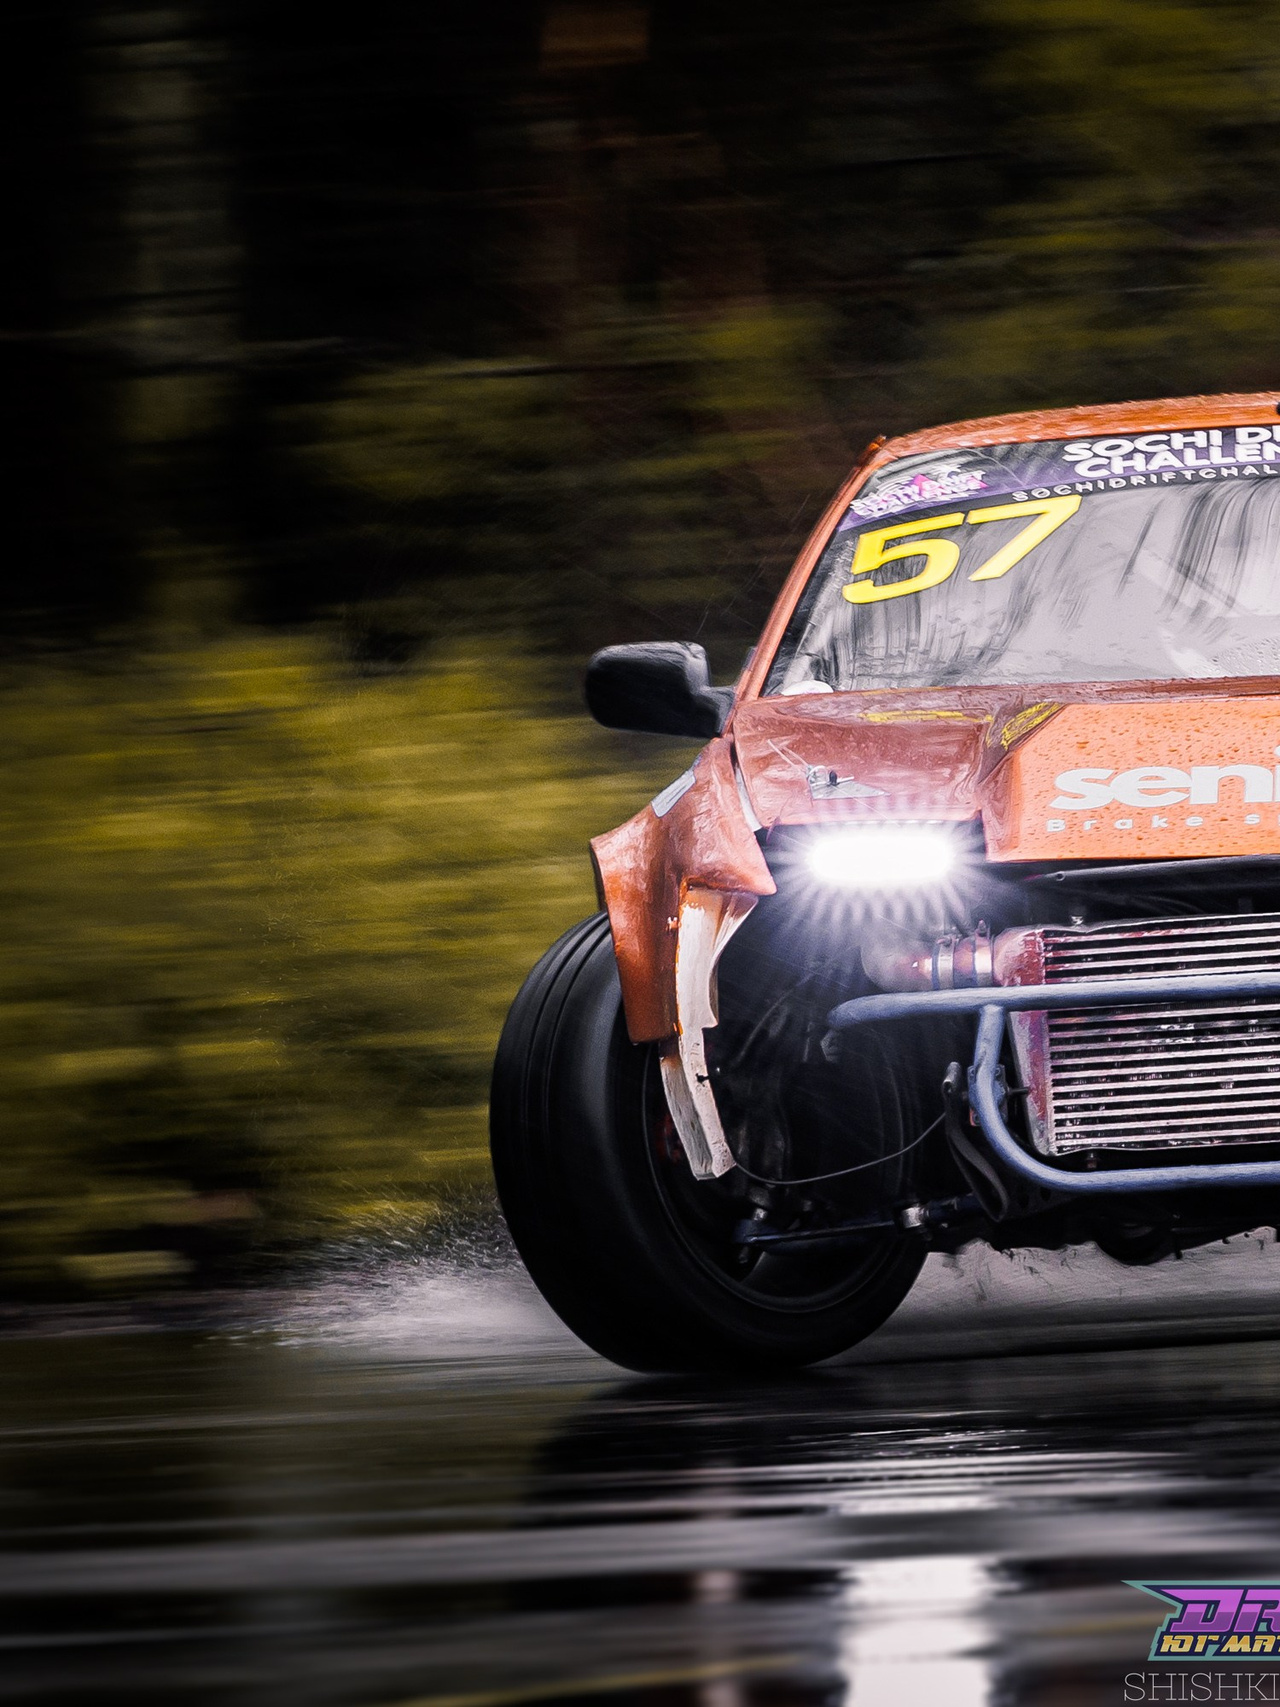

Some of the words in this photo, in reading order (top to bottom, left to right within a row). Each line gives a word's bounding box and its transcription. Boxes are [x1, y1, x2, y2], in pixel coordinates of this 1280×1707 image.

[1063, 428, 1223, 463] SOCHI
[842, 494, 1082, 604] 57
[1047, 814, 1203, 832] Brake
